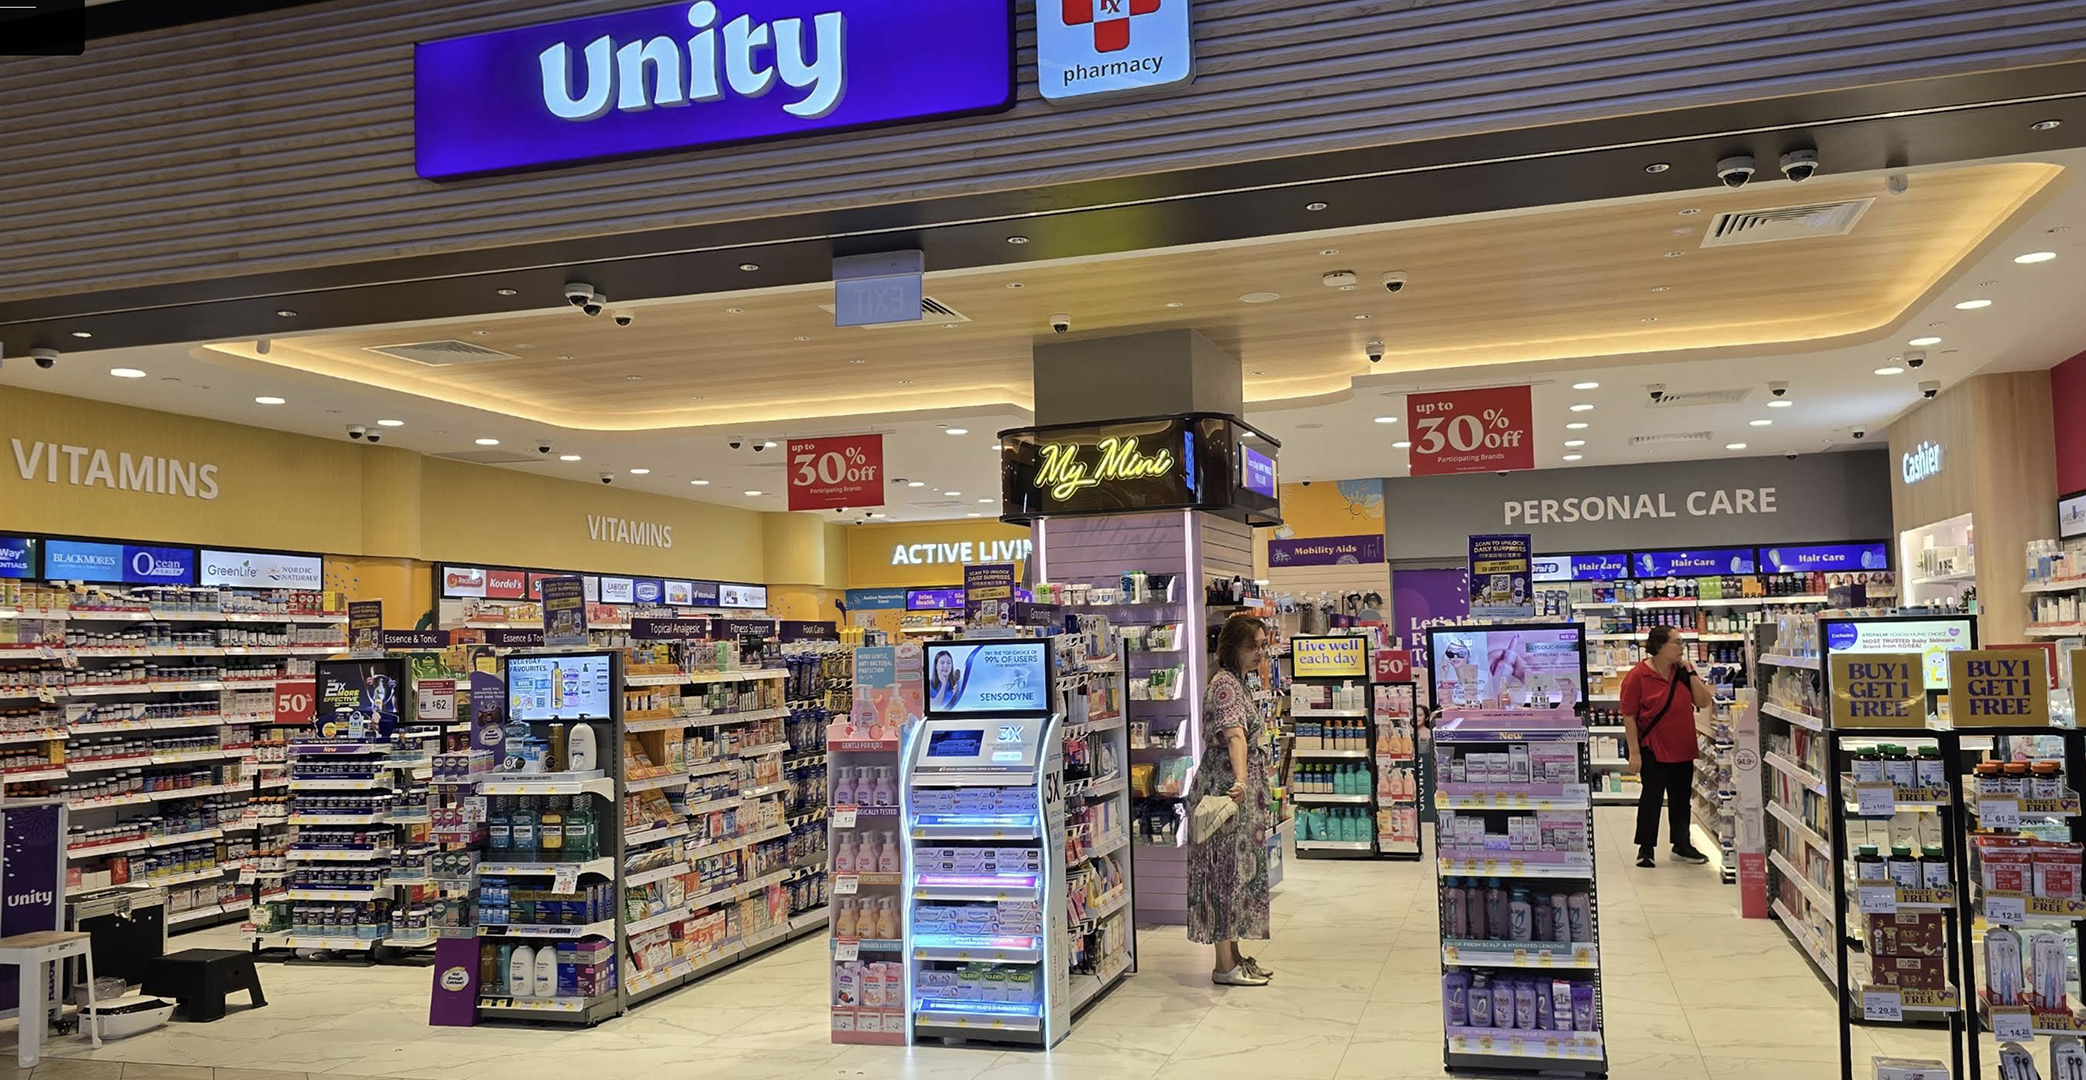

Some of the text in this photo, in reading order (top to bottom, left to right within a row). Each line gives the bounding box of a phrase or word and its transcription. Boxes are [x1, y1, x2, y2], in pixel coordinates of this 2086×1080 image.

[538, 0, 847, 120] Unity
[1064, 56, 1163, 87] pharmacy
[1416, 401, 1453, 415] up to
[1416, 408, 1523, 454] 30% off
[791, 444, 803, 452] up
[1437, 452, 1504, 463] Participating Brands
[1902, 440, 1940, 485] Cashier
[10, 437, 219, 500] VITAMINS
[792, 446, 877, 486] 30% off
[1034, 435, 1174, 501] My Mini
[1504, 486, 1777, 526] PERSONAL CARE
[587, 514, 673, 549] VITAMINS
[892, 539, 1032, 566] ACTIVE LIVIN
[1294, 545, 1357, 556] Mobility Aids
[53, 553, 117, 566] BLACKMORES
[132, 551, 181, 577] Ocean
[1671, 558, 1716, 567] Hair Care
[1799, 553, 1846, 563] Hair Care
[208, 562, 257, 578] GreenLife
[282, 566, 312, 574] NORDIC
[1578, 562, 1600, 571] Hair
[490, 578, 522, 590] Kordel's
[1030, 607, 1051, 622] Grooming
[651, 623, 700, 636] Topical Analgesic
[730, 623, 769, 636] Fitness Support
[802, 624, 825, 634] Foot Care
[384, 634, 437, 644] Essence & Tonic
[503, 633, 543, 643] Essence & Ton
[1298, 639, 1359, 651] Live well
[984, 655, 1038, 664] 99% OF USERS
[1299, 652, 1358, 666] each day
[1848, 662, 1909, 680] BUY 1
[1967, 660, 2031, 677] BUY 1
[1849, 681, 1909, 699] GET 1
[1968, 679, 2031, 696] GET 1
[980, 692, 1034, 701] SENSODYNE
[1850, 700, 1909, 717] FREE
[1969, 698, 2032, 716] FREE
[997, 726, 1024, 742] 3X
[1499, 731, 1523, 740] New
[1046, 771, 1061, 805] 3X
[1899, 792, 1928, 802] FREE
[879, 808, 898, 816] TESTED
[2026, 804, 2057, 813] FREE
[8, 889, 53, 907] Unity
[1903, 894, 1933, 903] FREE
[2032, 902, 2064, 913] FREE
[1904, 995, 1935, 1005] FREE
[2040, 1021, 2070, 1031] FREE
